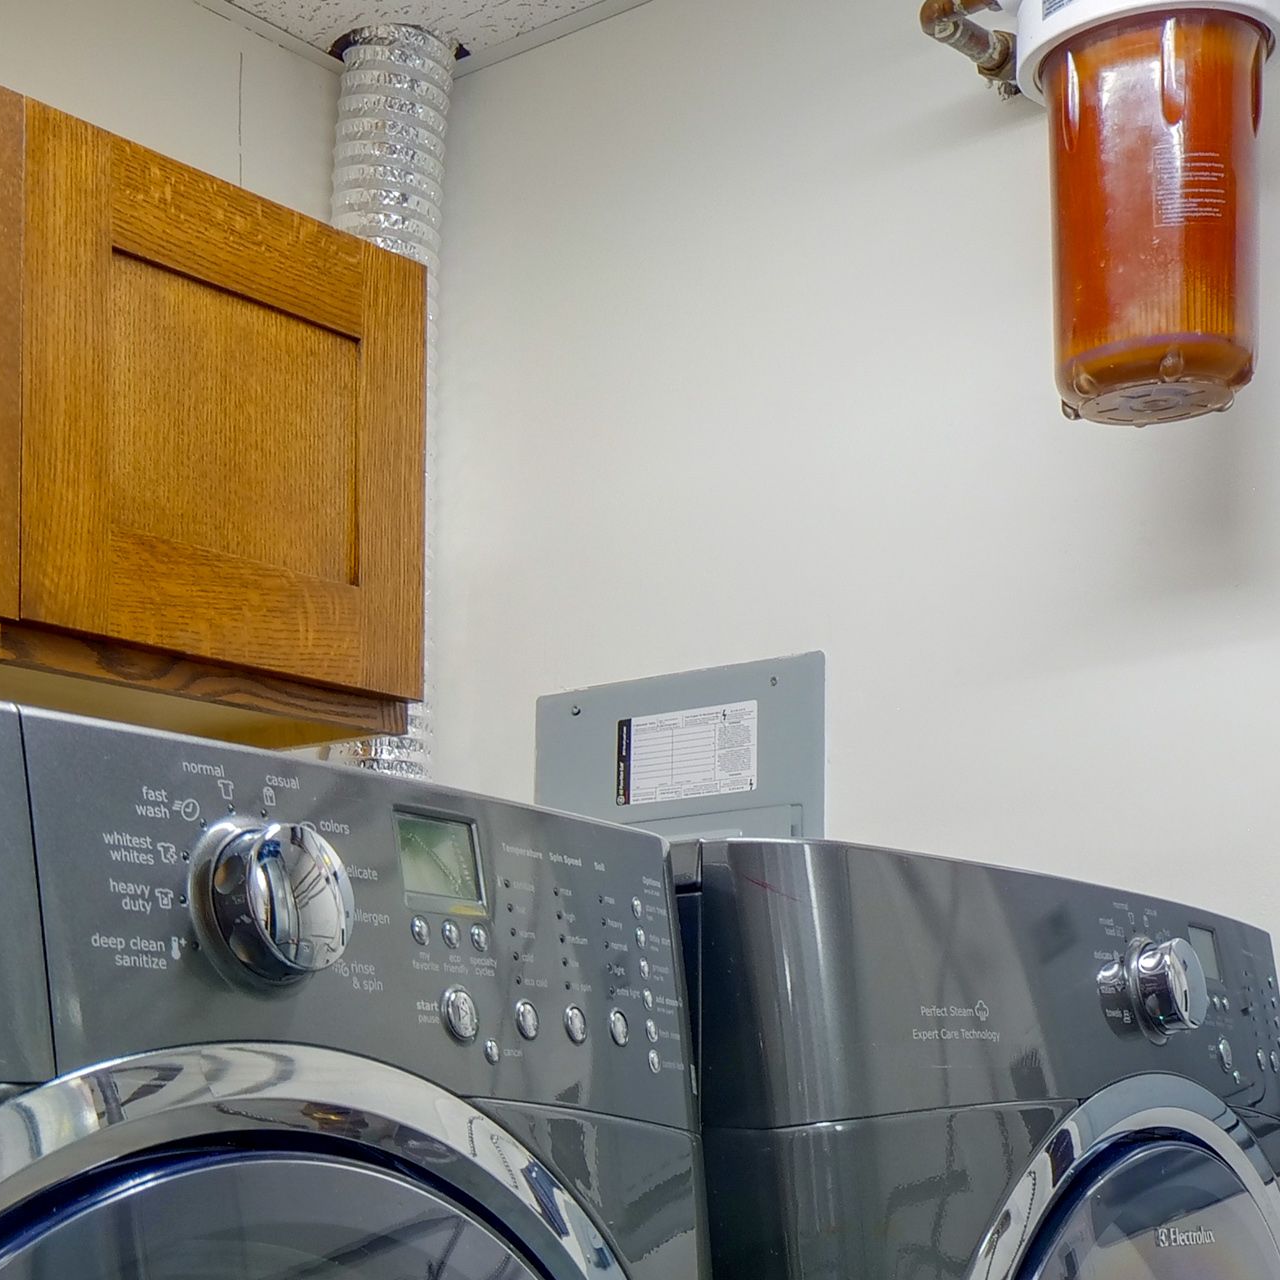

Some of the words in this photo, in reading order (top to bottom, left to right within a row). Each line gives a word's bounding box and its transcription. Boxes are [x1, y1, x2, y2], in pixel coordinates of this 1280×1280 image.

[182, 761, 225, 777] normal
[265, 774, 300, 790] casual
[142, 786, 168, 802] fast
[136, 803, 170, 819] wash
[320, 819, 351, 835] colors
[102, 832, 153, 849] whitest
[110, 848, 155, 865] whites
[346, 864, 379, 881] elicate
[109, 878, 150, 899] heavy
[121, 896, 152, 915] duty
[91, 932, 125, 951] deep
[129, 936, 166, 952] clean
[115, 953, 167, 969] sanitize
[351, 960, 376, 975] rinse
[412, 960, 440, 972] favorite
[443, 963, 468, 975] friendly
[475, 967, 495, 977] cycles
[352, 976, 360, 990] &
[363, 978, 384, 993] spin
[416, 1000, 439, 1011] start
[920, 1005, 948, 1017] Perfect
[949, 1005, 974, 1017] Steam
[418, 1014, 440, 1025] pause
[912, 1029, 939, 1041] Expert
[940, 1028, 959, 1039] Care
[961, 1029, 1000, 1042] Technology
[1170, 1226, 1215, 1246] Electrolux
